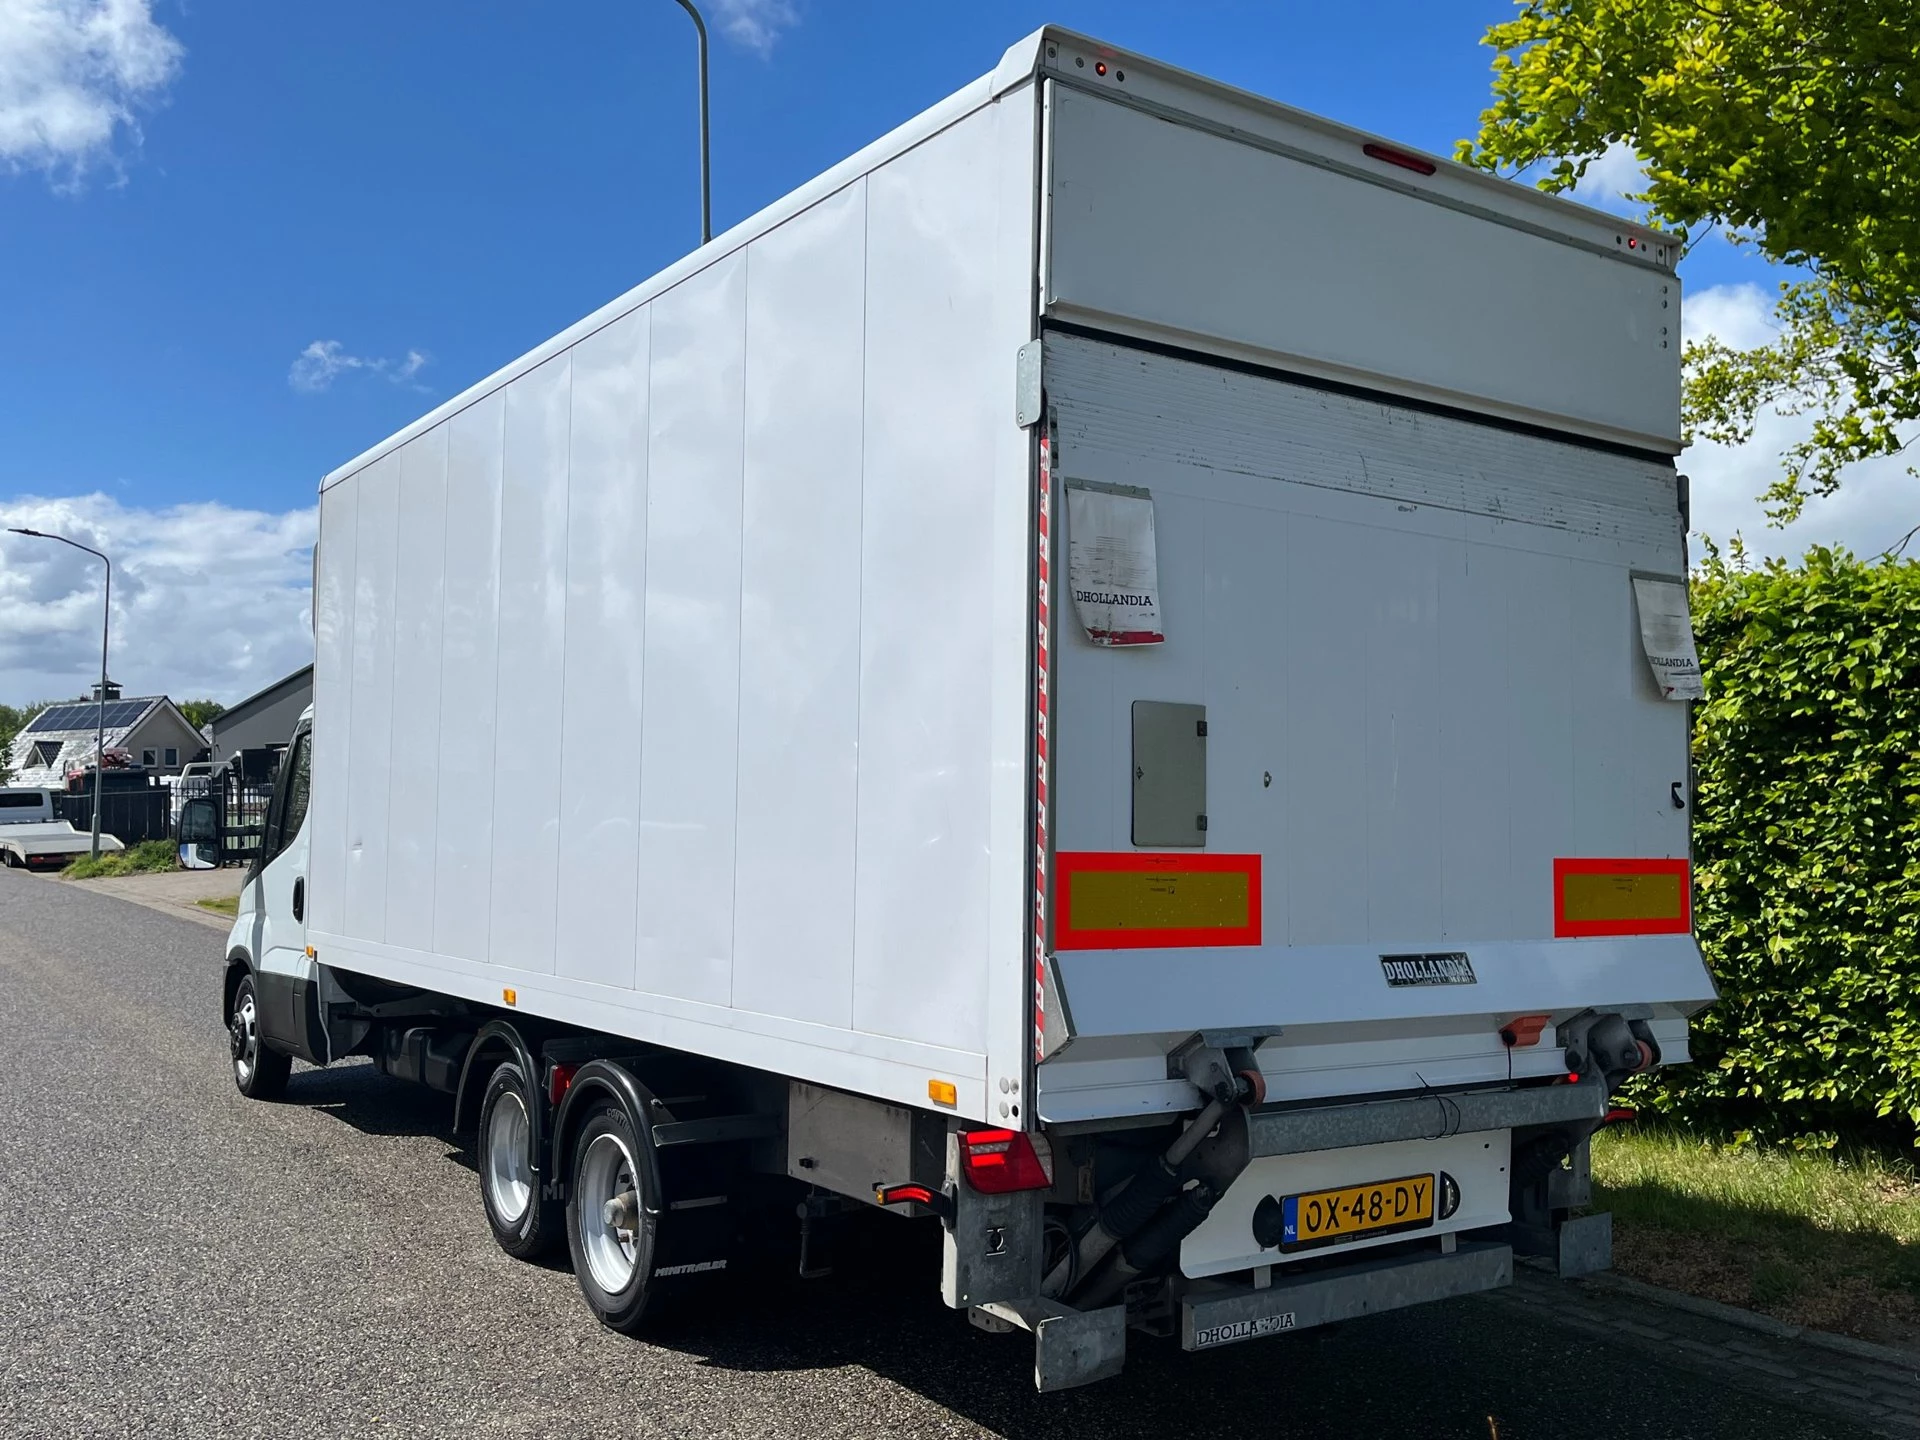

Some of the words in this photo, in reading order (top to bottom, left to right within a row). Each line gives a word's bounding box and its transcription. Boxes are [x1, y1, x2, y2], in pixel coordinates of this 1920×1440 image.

[1076, 590, 1153, 606] DHOLLANDIA
[1383, 959, 1472, 980] DHOLLANDIA
[1306, 1182, 1426, 1232] OX-48-DY
[1284, 1225, 1296, 1235] NL
[654, 1259, 727, 1277] MINITRAILER
